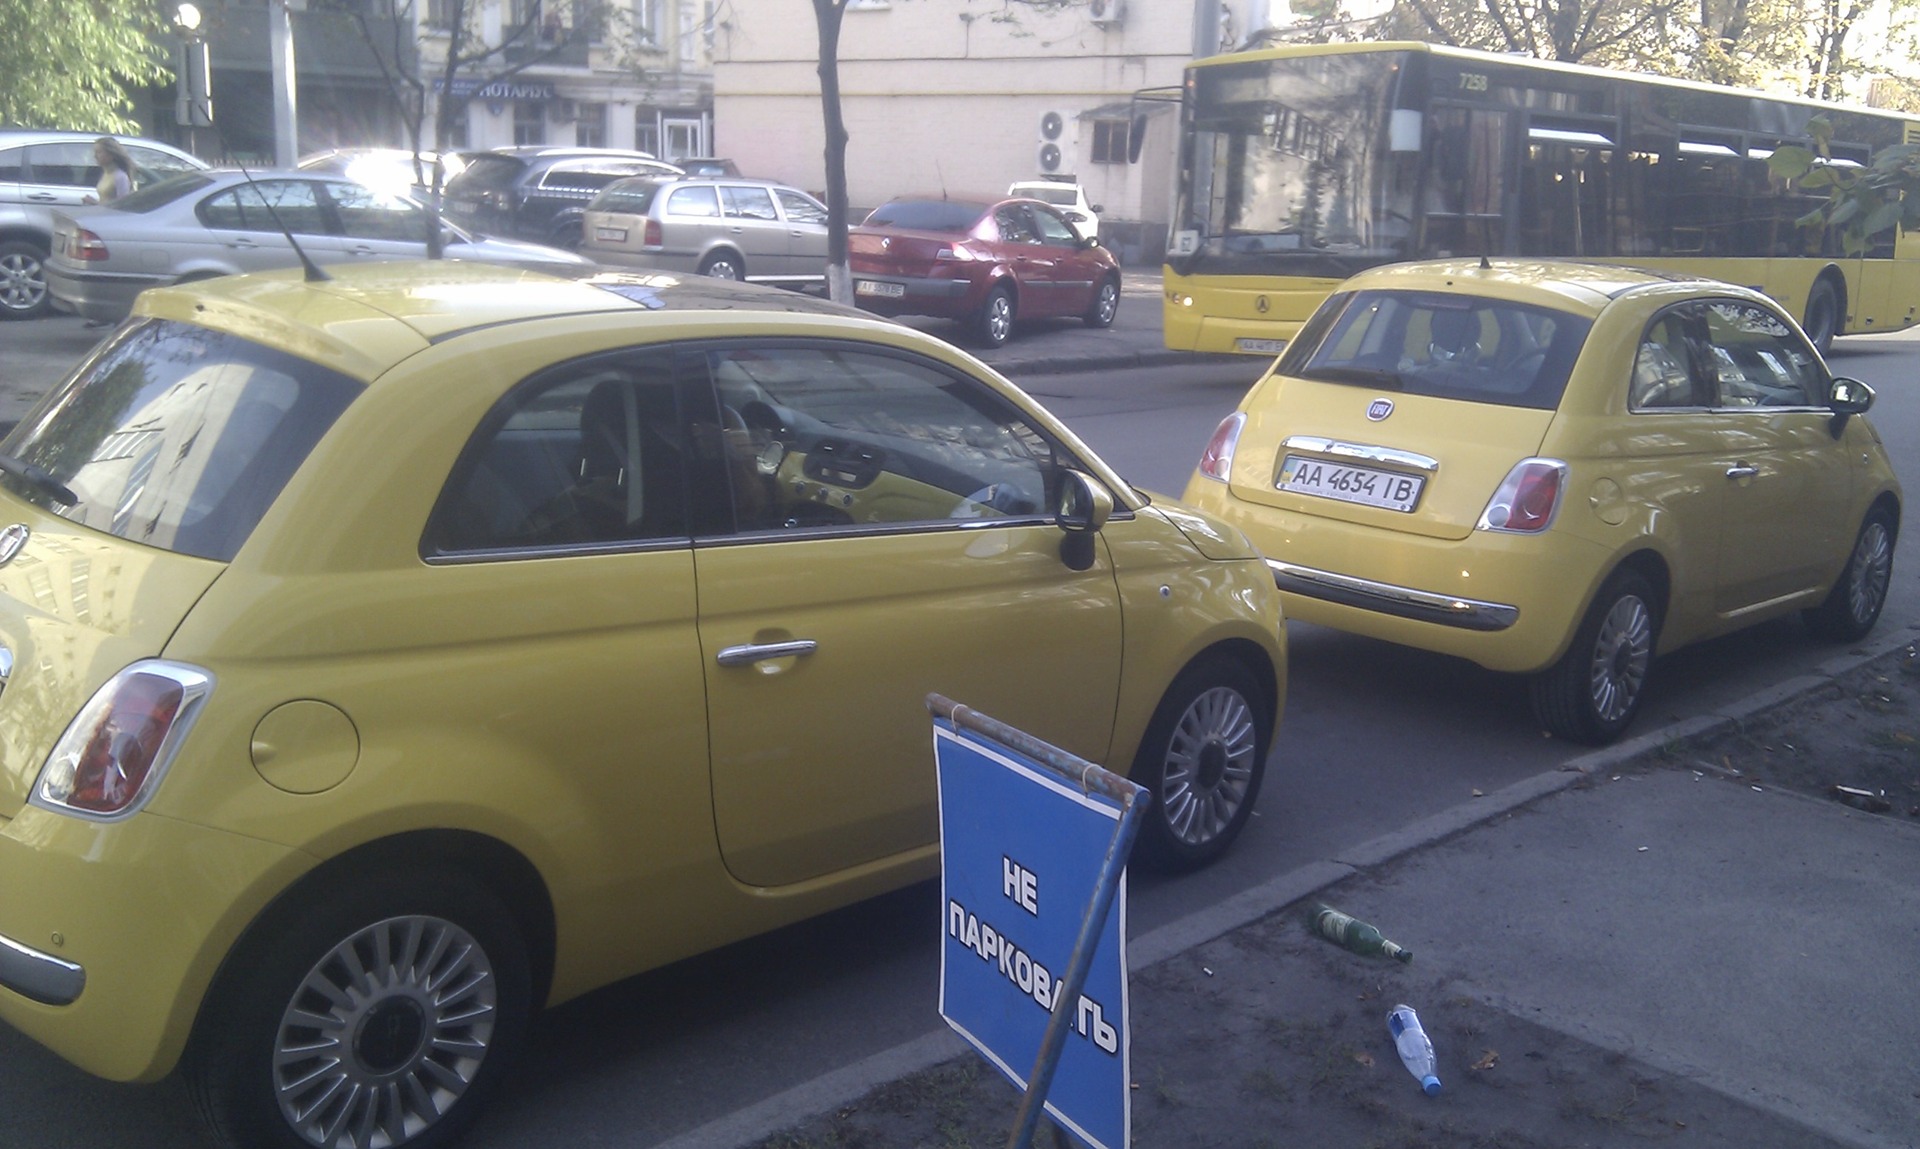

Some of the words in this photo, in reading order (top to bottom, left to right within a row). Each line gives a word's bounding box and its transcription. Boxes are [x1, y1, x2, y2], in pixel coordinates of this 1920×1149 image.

[1459, 73, 1488, 91] 7258
[1292, 464, 1323, 487] AA
[1327, 469, 1378, 496] 4654
[1383, 477, 1413, 501] IB
[1003, 856, 1038, 916] НЕ
